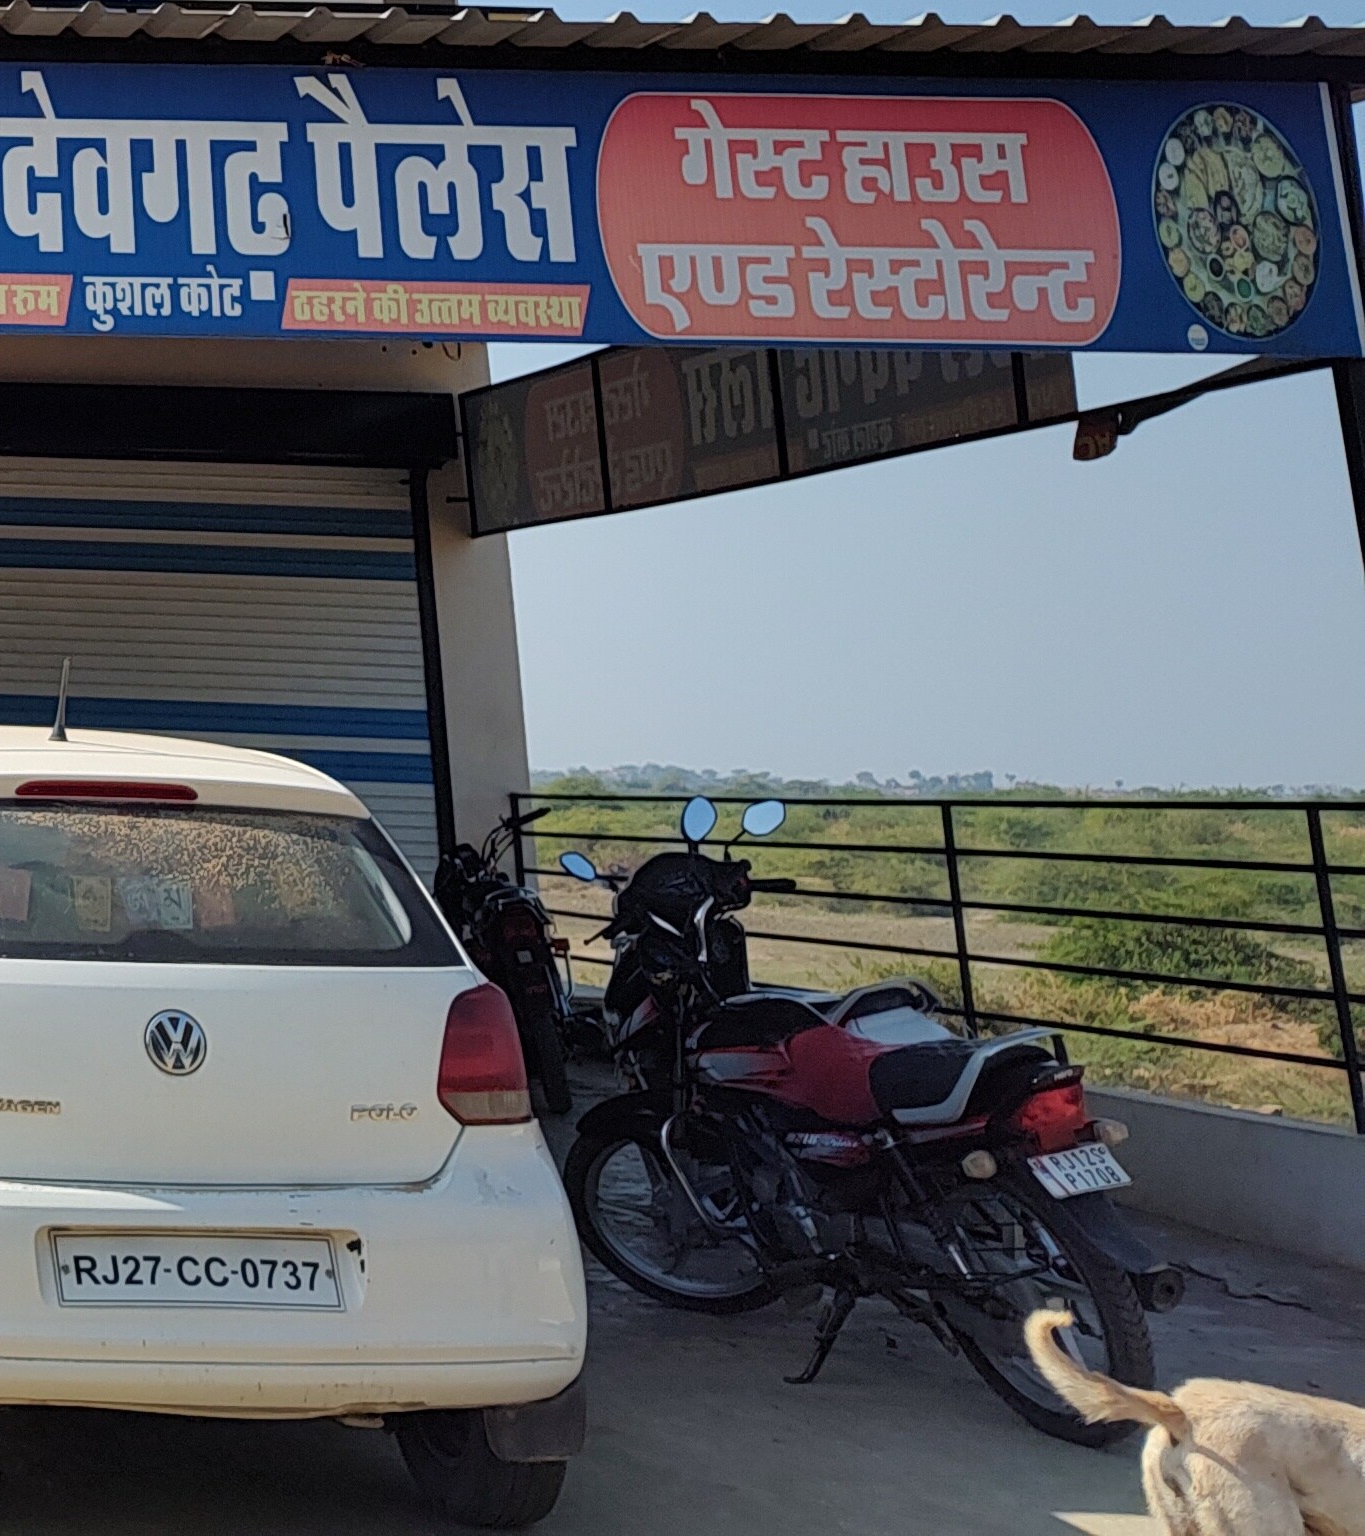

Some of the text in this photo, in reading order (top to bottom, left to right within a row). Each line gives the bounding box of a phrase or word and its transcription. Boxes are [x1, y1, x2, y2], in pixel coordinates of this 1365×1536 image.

[293, 73, 578, 263] पैलेस
[675, 98, 1028, 205] गेस्ट हाउस
[82, 265, 242, 332] कुशल कोट
[292, 282, 582, 329] ठहरने की उत्तम व्यवस्था
[637, 216, 1096, 332] एण्ड रेस्टोरेन्ट
[350, 1102, 418, 1122] POLO
[72, 1254, 320, 1292] RJ27-CC-0737
